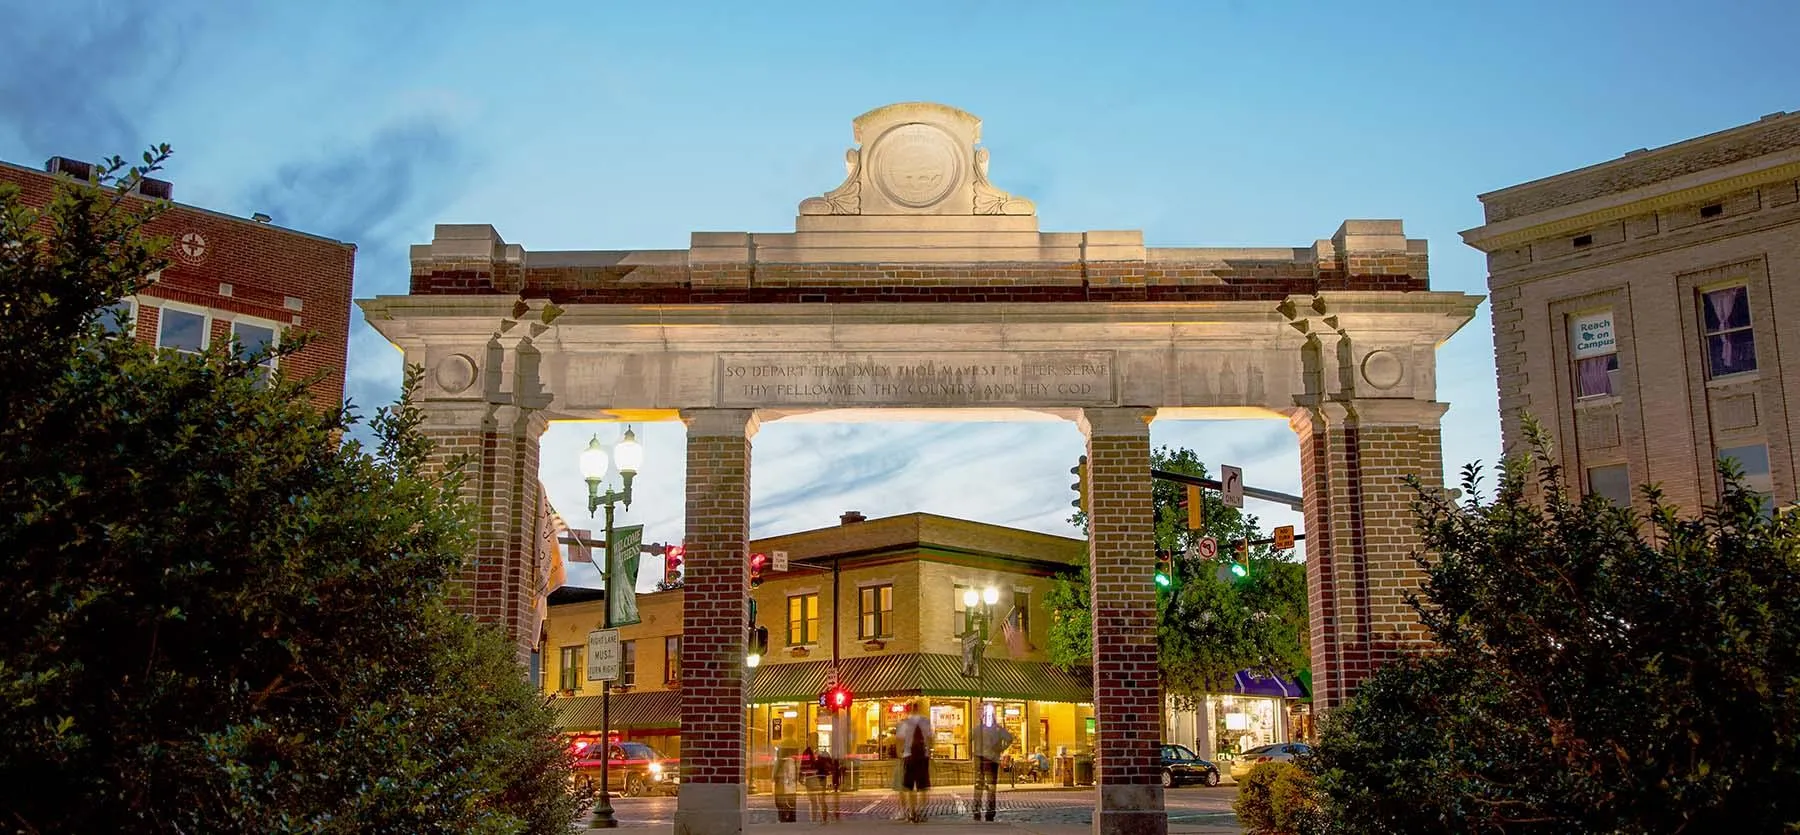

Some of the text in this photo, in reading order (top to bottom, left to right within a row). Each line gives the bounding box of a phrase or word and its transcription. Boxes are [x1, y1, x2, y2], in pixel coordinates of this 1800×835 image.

[1580, 319, 1610, 331] Reach
[1597, 331, 1609, 339] on
[1577, 338, 1615, 350] Campus
[725, 366, 746, 377] SO
[752, 366, 807, 377] DEPART
[813, 366, 846, 377] THAT
[852, 366, 890, 377] DAILY
[1063, 364, 1109, 377] SERVE
[743, 383, 1092, 396] THY FELLOWMEN THY COUNTRY AND THY GOD
[1225, 494, 1240, 504] ONLY
